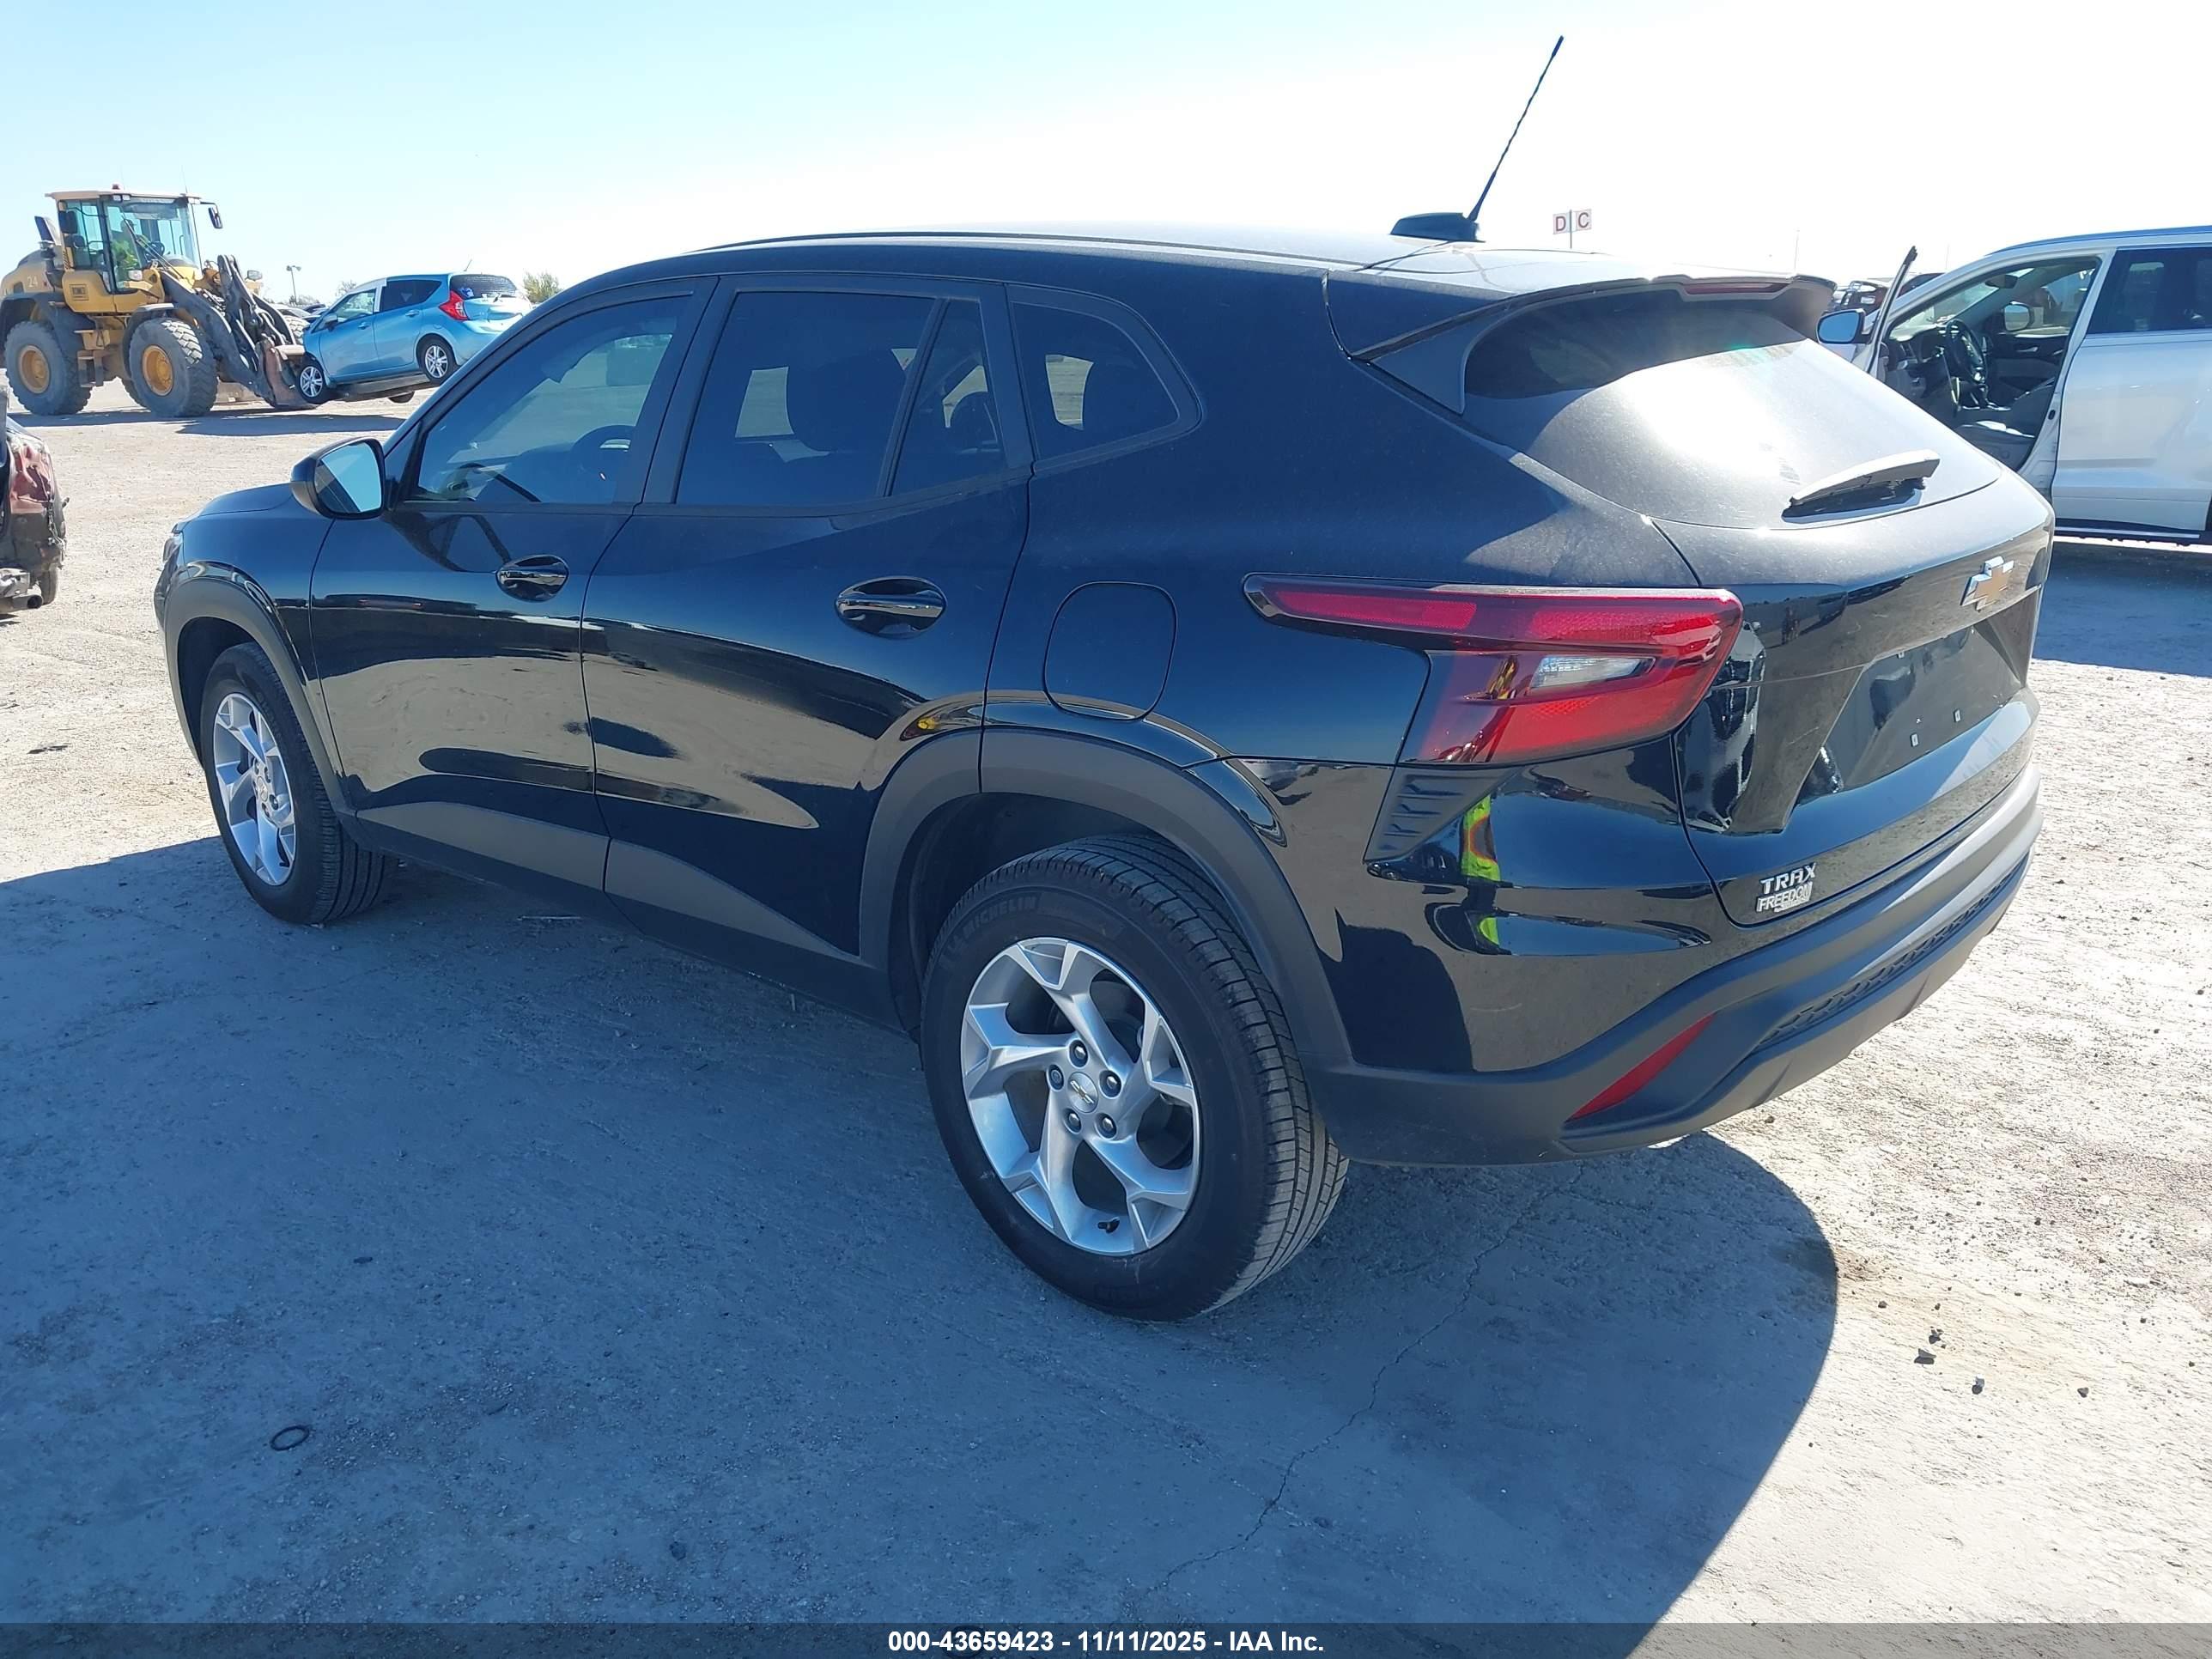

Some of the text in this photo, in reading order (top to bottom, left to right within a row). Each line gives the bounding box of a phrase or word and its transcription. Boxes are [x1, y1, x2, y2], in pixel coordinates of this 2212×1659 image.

[1555, 216, 1566, 232] D
[1577, 212, 1589, 228] C
[27, 276, 39, 288] 24
[1760, 862, 1816, 894] TRAX
[963, 896, 1038, 939] MICHELIN
